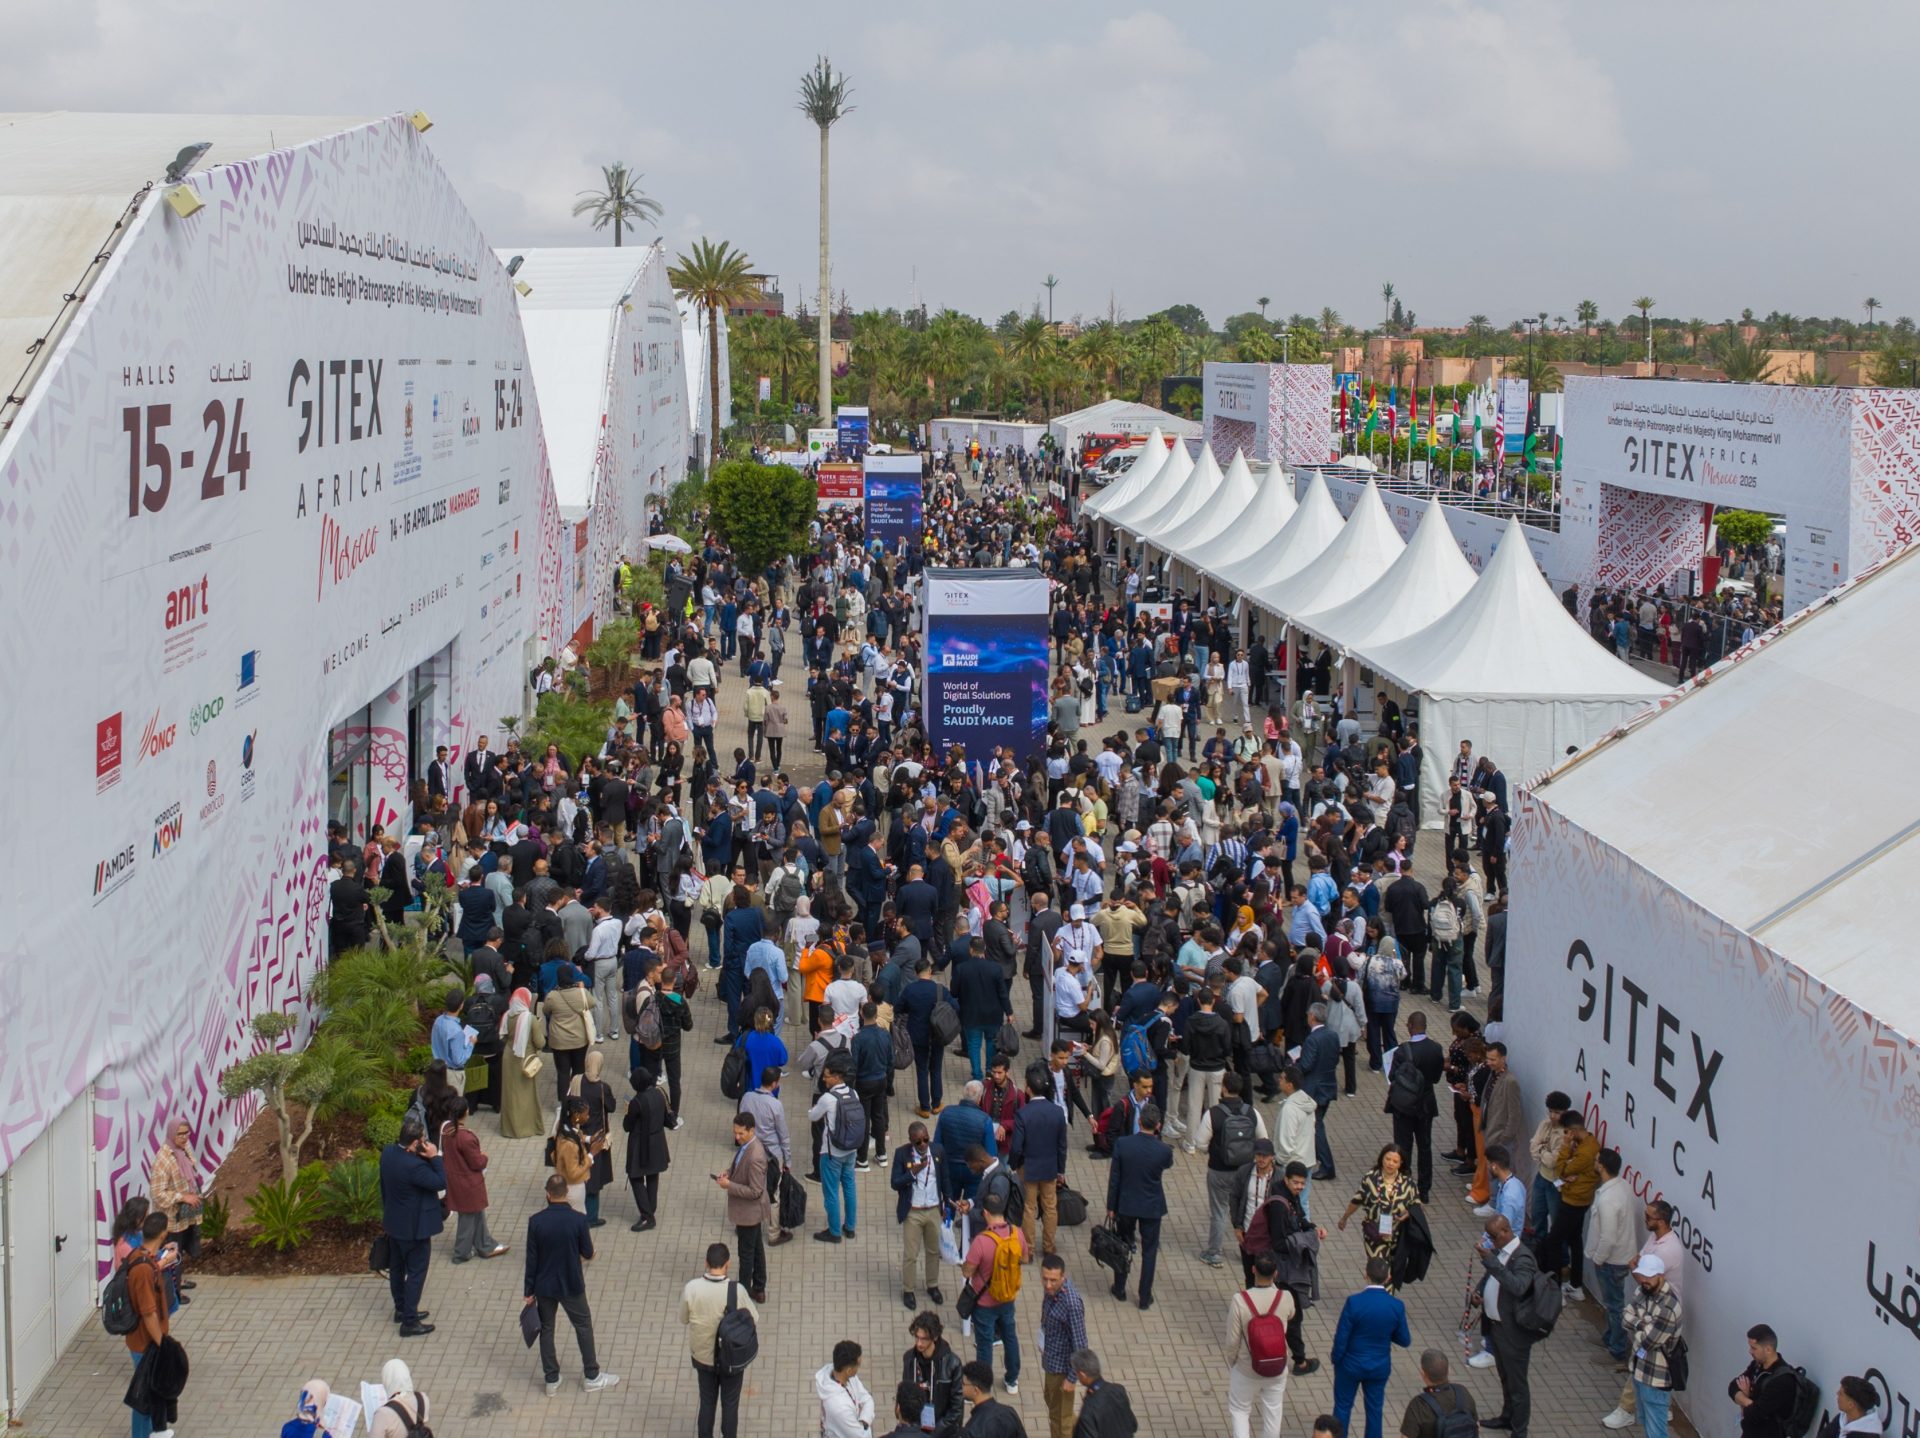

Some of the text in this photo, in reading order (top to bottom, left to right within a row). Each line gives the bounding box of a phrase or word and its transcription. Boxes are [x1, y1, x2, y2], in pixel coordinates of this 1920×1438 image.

[298, 218, 337, 249] السادس
[339, 232, 362, 257] محمد
[288, 264, 318, 295] Under
[320, 268, 336, 298] the
[338, 271, 357, 305] High
[359, 275, 396, 309] Patronage
[397, 280, 404, 304] of
[405, 281, 415, 306] His
[416, 284, 437, 314] Majesty
[438, 289, 449, 316] King
[123, 365, 175, 386] HALLS
[288, 358, 384, 454] GITEX
[495, 378, 523, 432] 15-24
[1608, 416, 1781, 445] Under the High Patronage of His Majesty King Mohammed VI
[123, 398, 251, 517] 15-24
[1624, 436, 1758, 482] GITEX AFRICA
[1701, 460, 1757, 488] Morocco 2025
[297, 462, 382, 519] AFRICA
[390, 518, 398, 541] 14
[404, 512, 411, 536] 16
[412, 504, 431, 533] APRIL
[432, 498, 447, 524] 2025
[449, 486, 480, 516] MARRAKECH
[317, 512, 379, 604] Morocco
[165, 571, 209, 630] anrt
[323, 632, 369, 675] WELCOME
[943, 682, 979, 690] World of
[943, 691, 1011, 701] Digital Solutions
[202, 696, 224, 723] OCP
[943, 704, 986, 716] Proudly
[943, 716, 1014, 726] SAUDI MADE
[150, 723, 177, 757] ONCF
[154, 801, 180, 828] MOROCCO
[200, 793, 225, 821] MOROCCO
[152, 812, 183, 860] NOW
[105, 844, 135, 883] AMDIE
[1566, 938, 1724, 1144] GITEX
[1575, 1047, 1717, 1211] AFRICA
